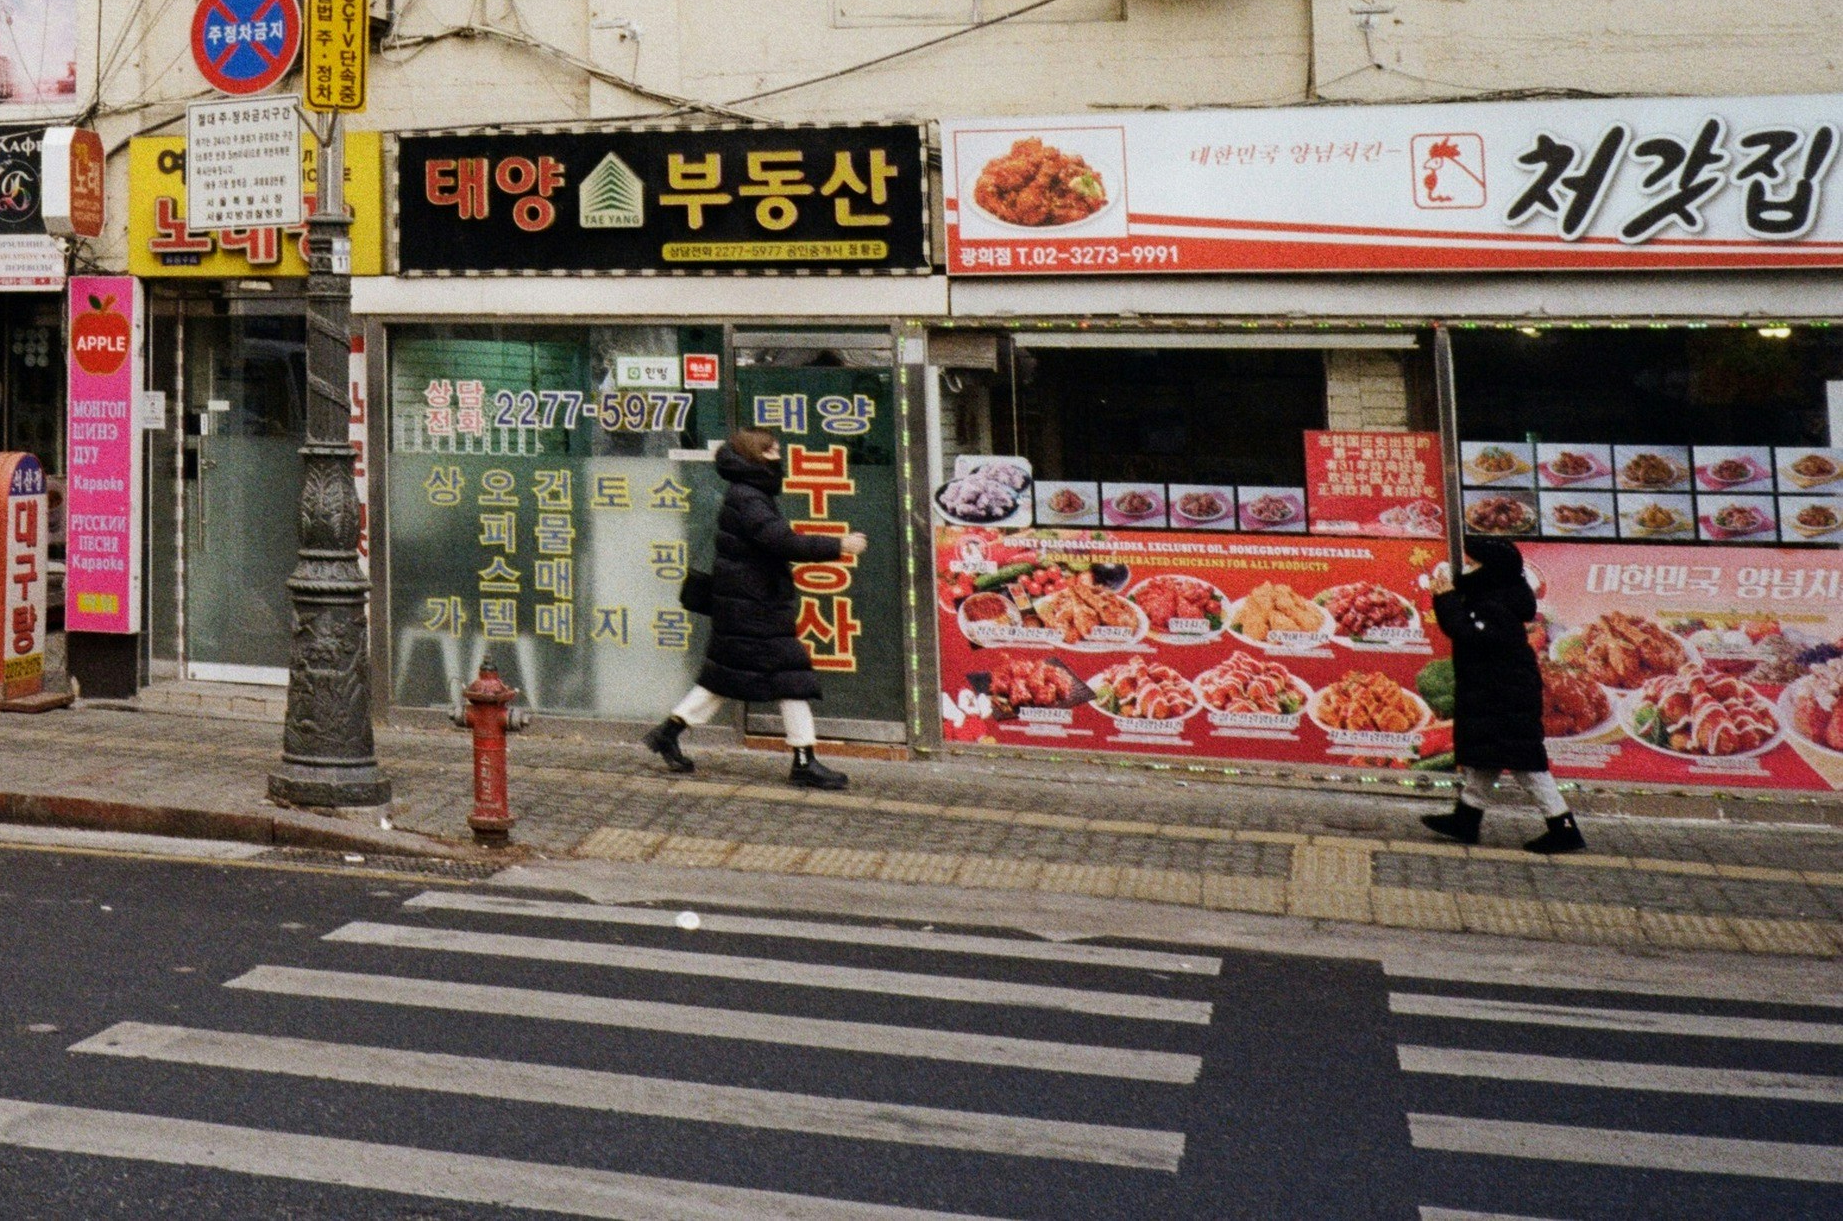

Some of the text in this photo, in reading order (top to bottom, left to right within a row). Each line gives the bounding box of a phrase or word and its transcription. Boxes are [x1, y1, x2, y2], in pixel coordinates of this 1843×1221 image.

[206, 20, 284, 45] 주정차금지
[1190, 142, 1280, 167] 대한민국
[424, 148, 899, 231] 태양 부동산
[1506, 117, 1834, 236] 처갓집
[583, 212, 641, 225] TAE YANG
[960, 244, 1179, 267] 광희점 T.02-3273-9991
[76, 334, 126, 353] APPLE
[425, 379, 486, 407] 상담
[426, 389, 693, 436] 전화 2277-5977
[754, 393, 876, 434] 태양
[477, 469, 521, 640] 오피스텔
[532, 467, 576, 645] 건물매매
[1003, 537, 1039, 549] HONEY
[1148, 542, 1206, 555] EXCLUSIVE
[1229, 544, 1300, 558] HOMEGROWN
[12, 498, 38, 655] 대구탕
[1227, 559, 1248, 569] FOR
[1250, 560, 1270, 570] ALL
[1586, 563, 1843, 600] 대한민국 양념치
